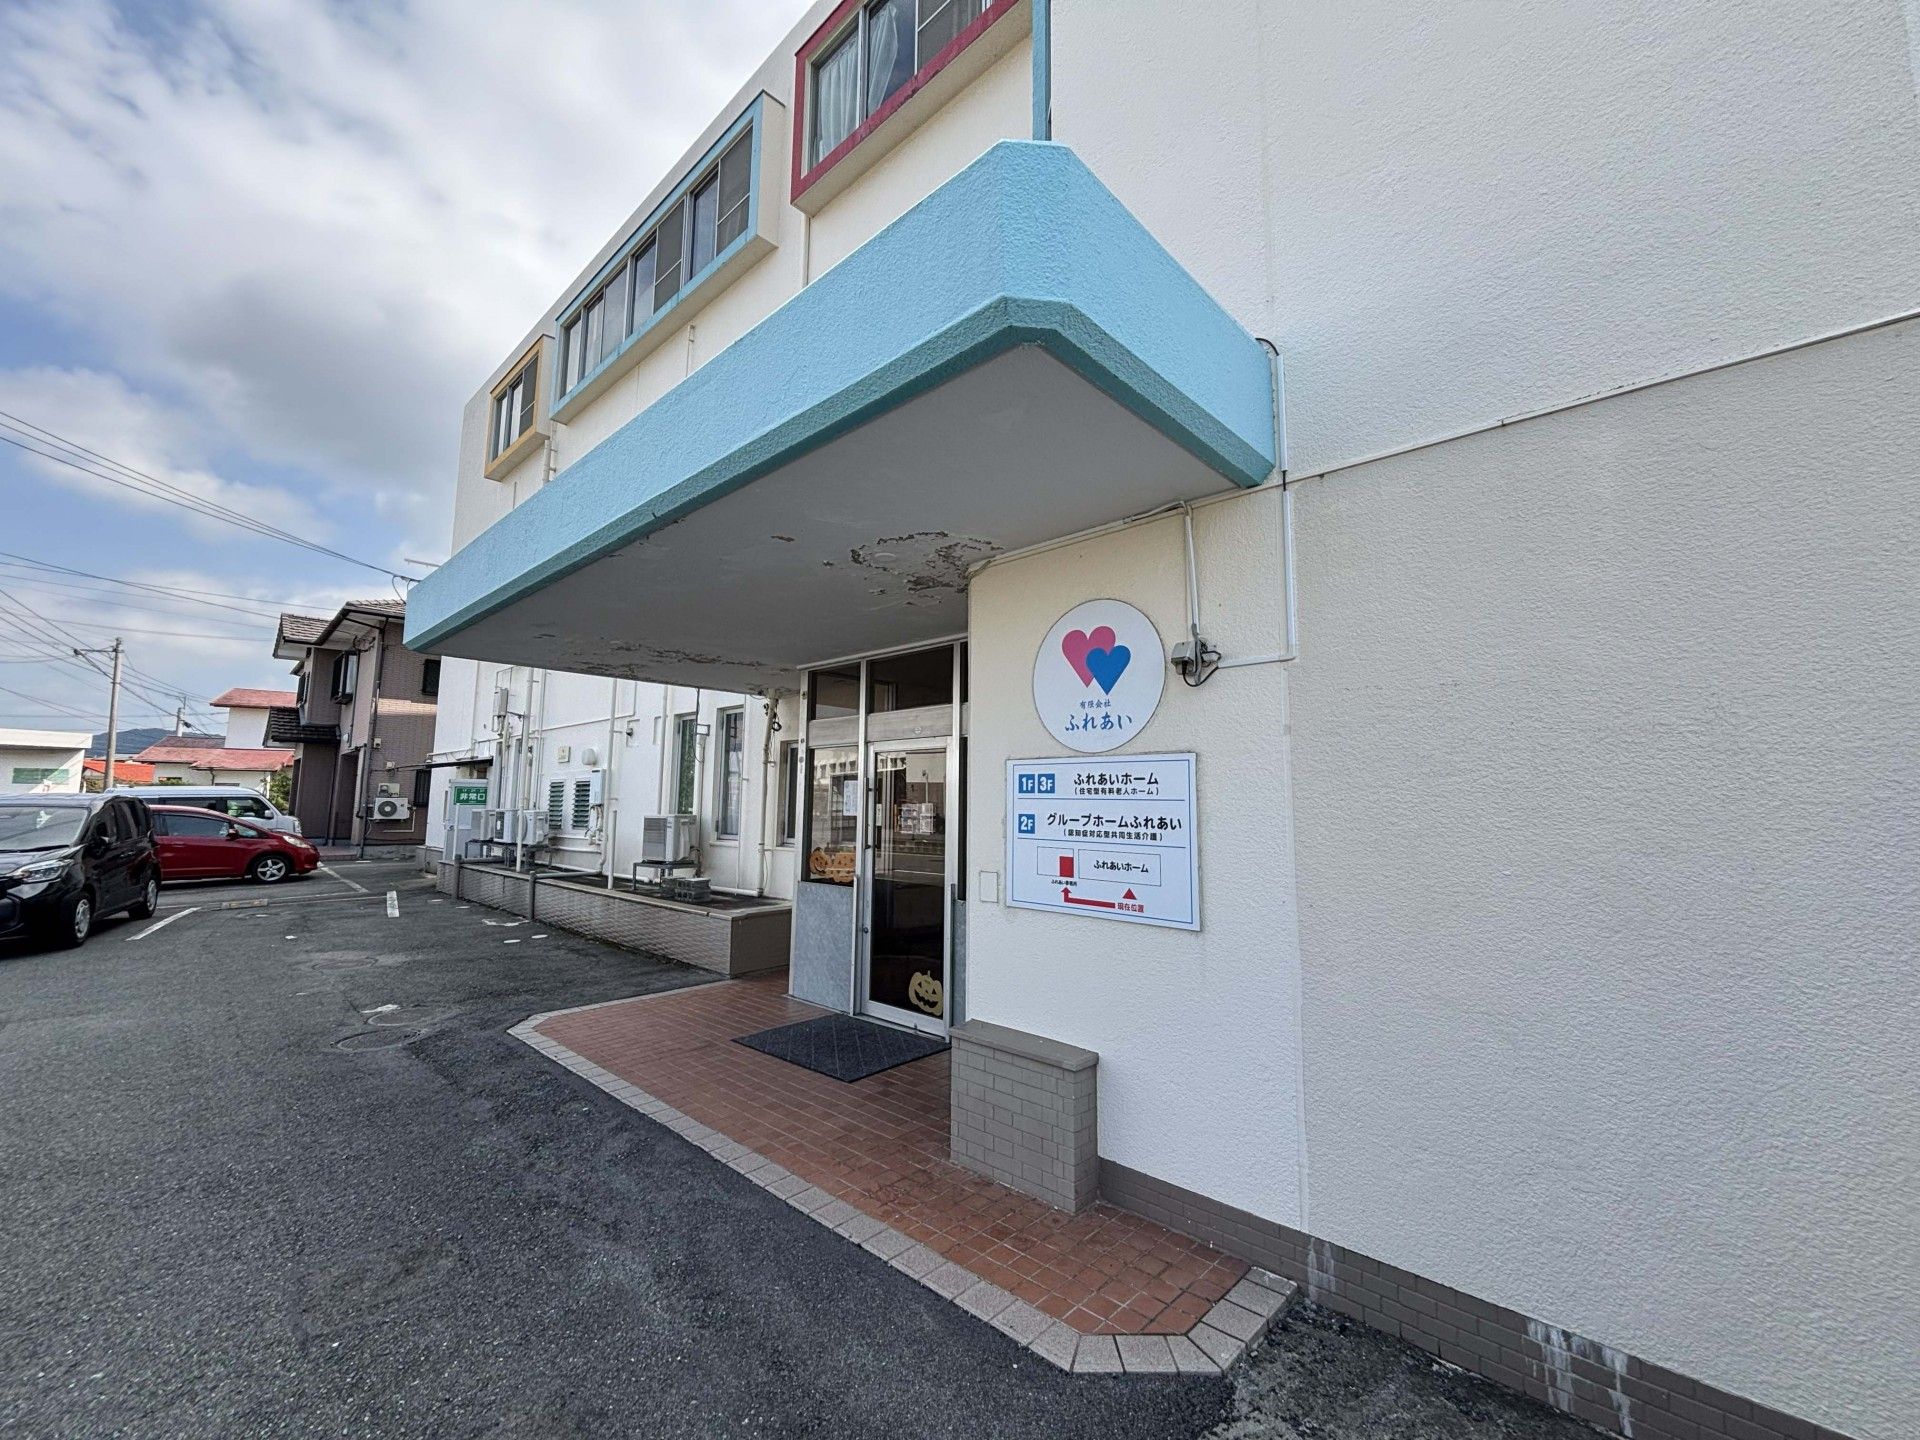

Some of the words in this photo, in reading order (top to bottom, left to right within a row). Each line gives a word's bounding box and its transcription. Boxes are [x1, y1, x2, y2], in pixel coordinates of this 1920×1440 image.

[1080, 698, 1111, 709] 有限会社
[1064, 711, 1132, 732] ふれあい
[1020, 777, 1034, 792] 1F
[1039, 776, 1053, 792] 3F
[1073, 772, 1159, 786] ふれあいホーム
[1020, 816, 1034, 831] 2F
[1047, 813, 1182, 831] グループホームふれあい
[1093, 860, 1149, 873] ふれあいホーム
[1117, 902, 1145, 913] 現在位置
